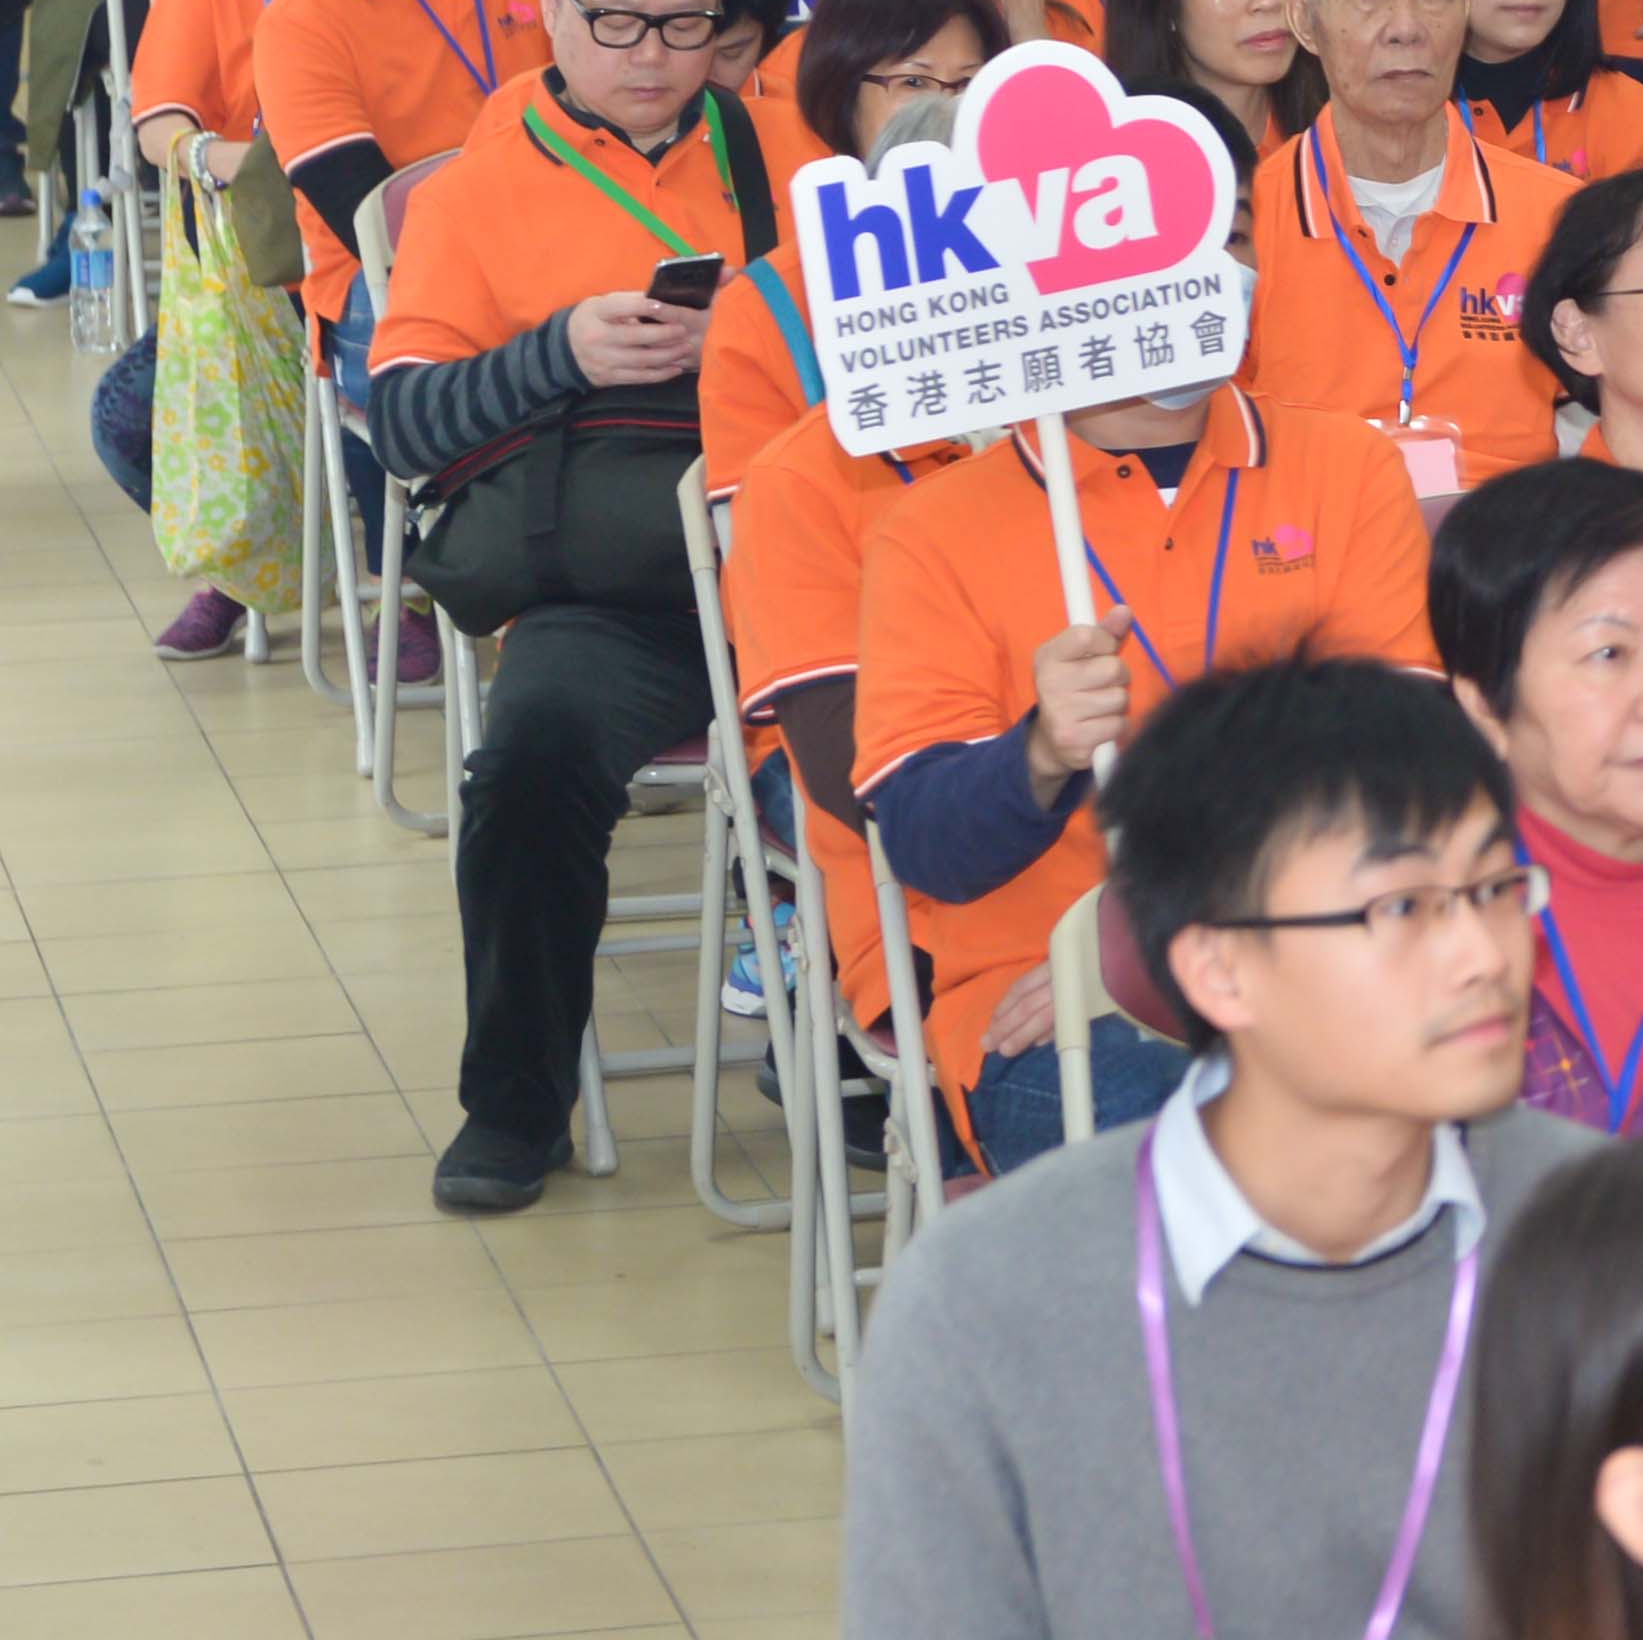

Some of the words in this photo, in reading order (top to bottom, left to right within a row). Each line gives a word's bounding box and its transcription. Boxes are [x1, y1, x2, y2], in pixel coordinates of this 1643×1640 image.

[816, 153, 1159, 302] hkva
[835, 300, 919, 339] HONG
[927, 282, 1010, 321] KONG
[839, 315, 1030, 374] VOLUNTEERS
[1039, 272, 1223, 333] ASSOCIATION
[847, 310, 1228, 432] 香港志願者協會
